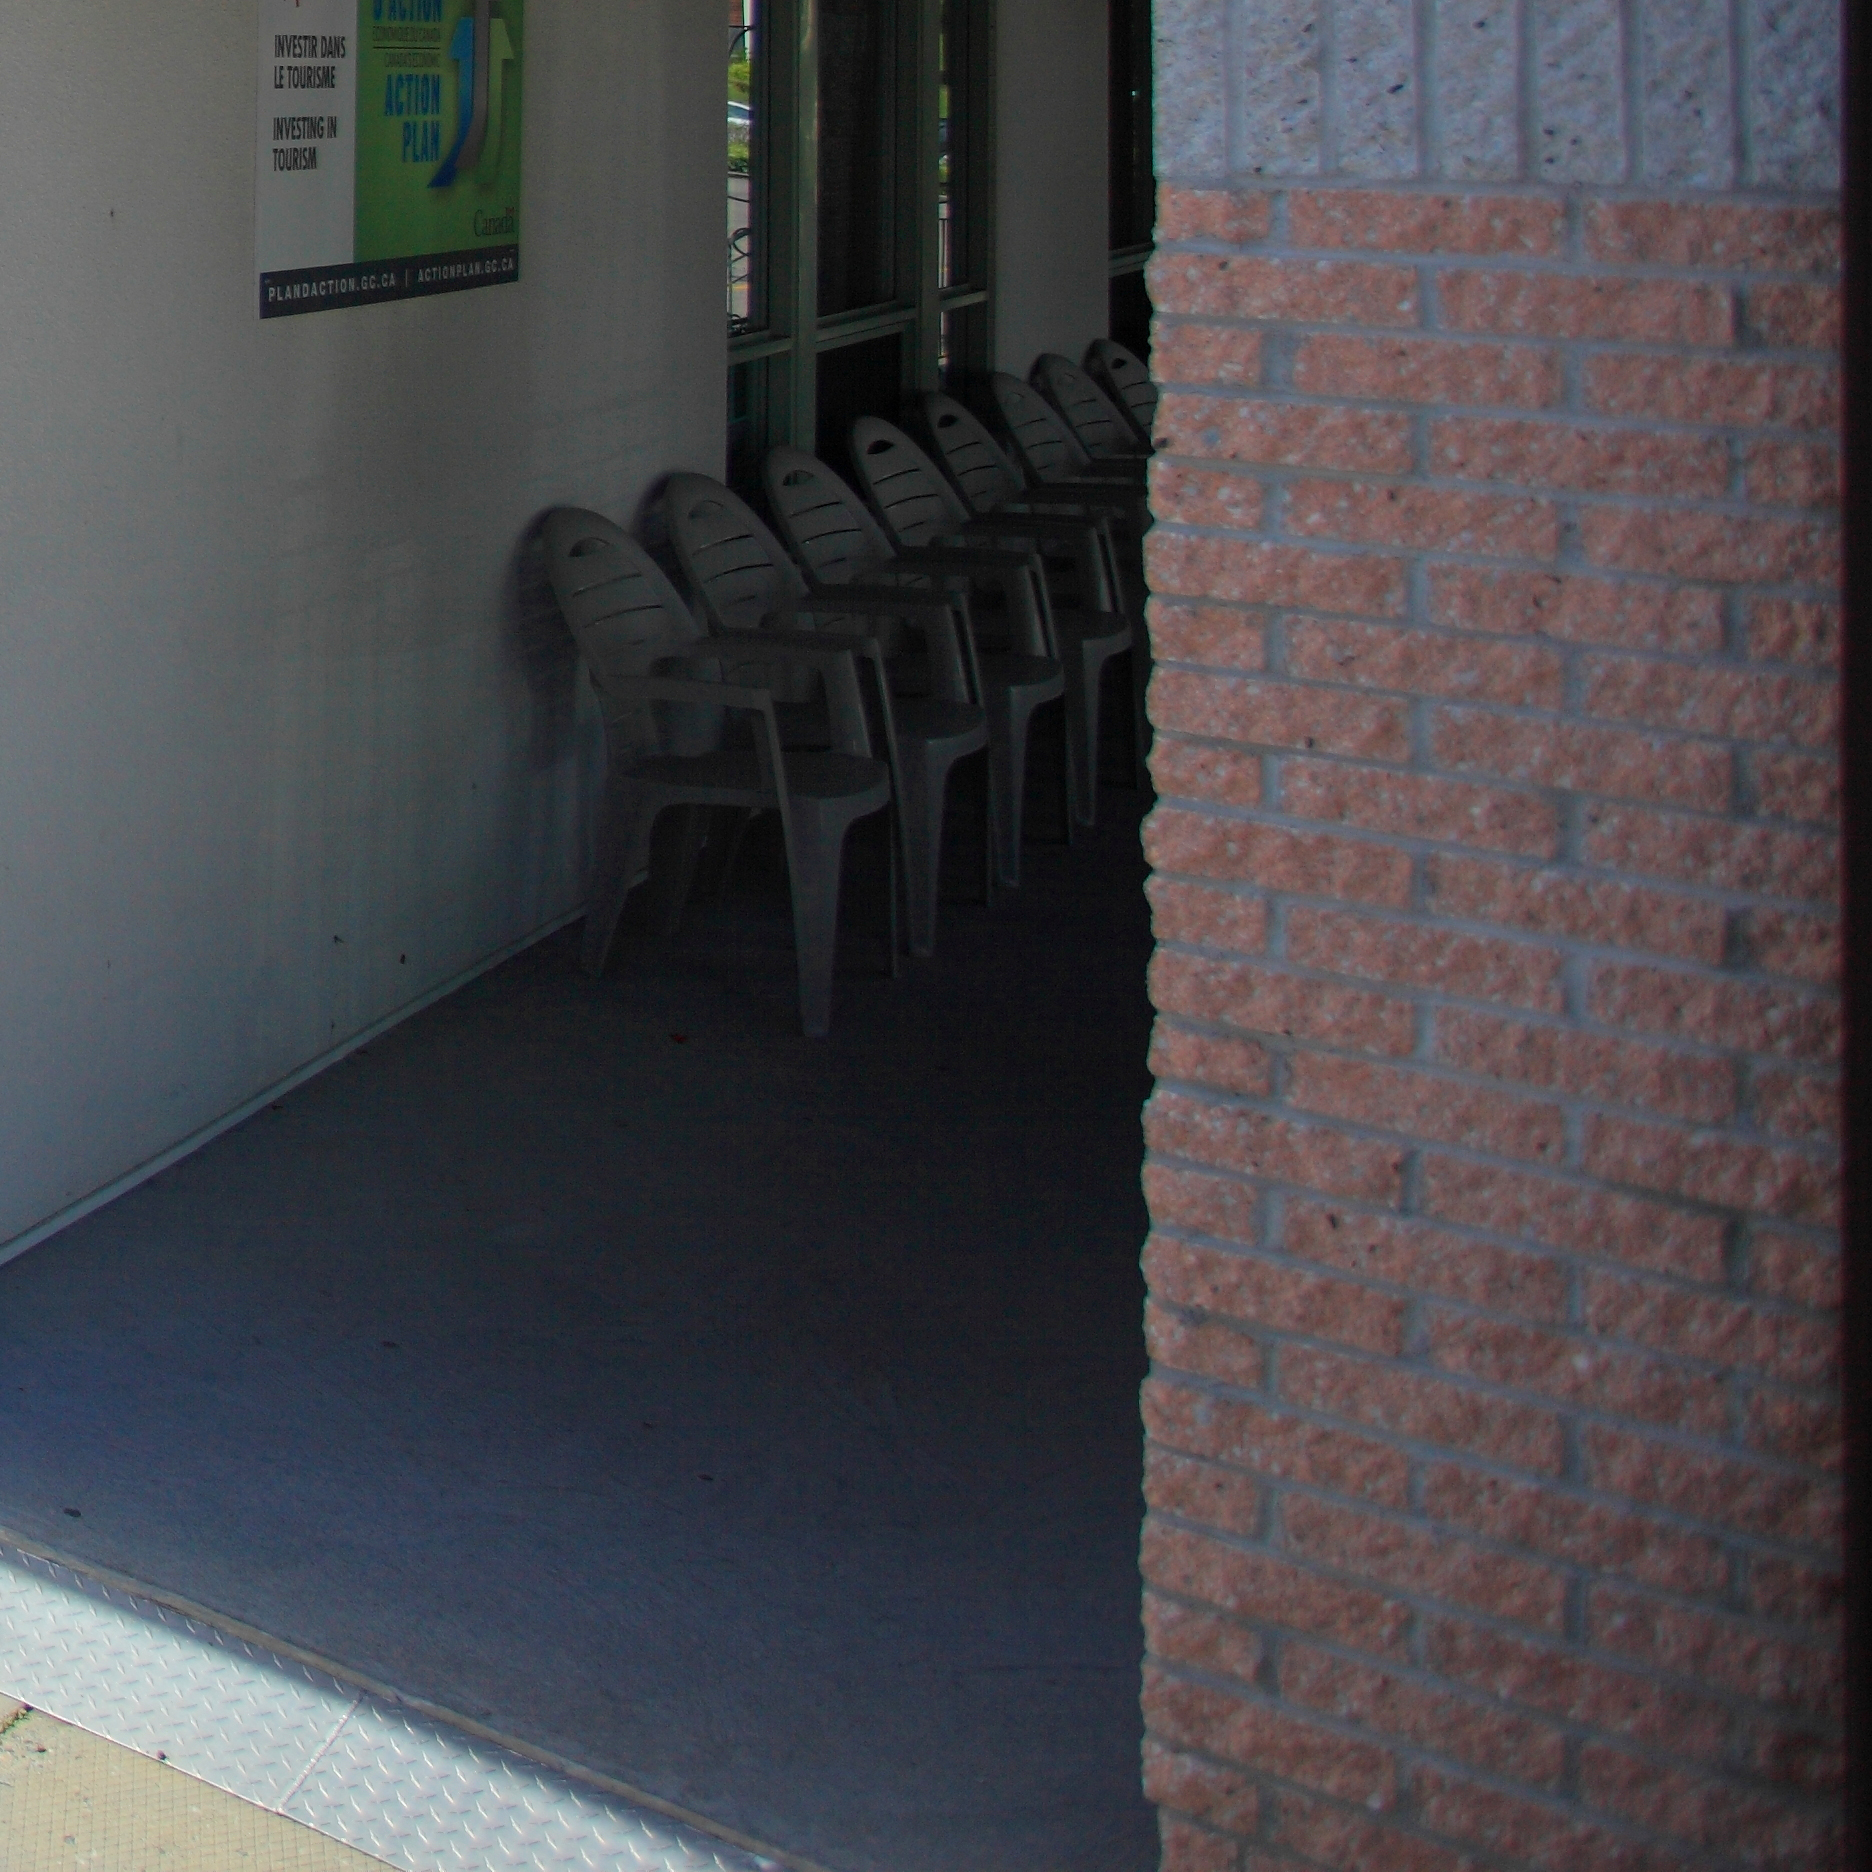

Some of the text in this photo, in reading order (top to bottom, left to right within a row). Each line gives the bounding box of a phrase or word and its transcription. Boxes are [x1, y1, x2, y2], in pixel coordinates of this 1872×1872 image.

[274, 34, 346, 59] INVESTIR DANS
[274, 66, 336, 89] LE TOURISME
[384, 74, 441, 116] ACTION
[272, 116, 337, 141] INVESTING IN
[402, 122, 440, 163] PLAN
[272, 147, 317, 172] TOURISM
[474, 210, 514, 238] Canada
[268, 256, 514, 302] PLANDACTION.GC.CA ACTIONPLAN.GC.CA
